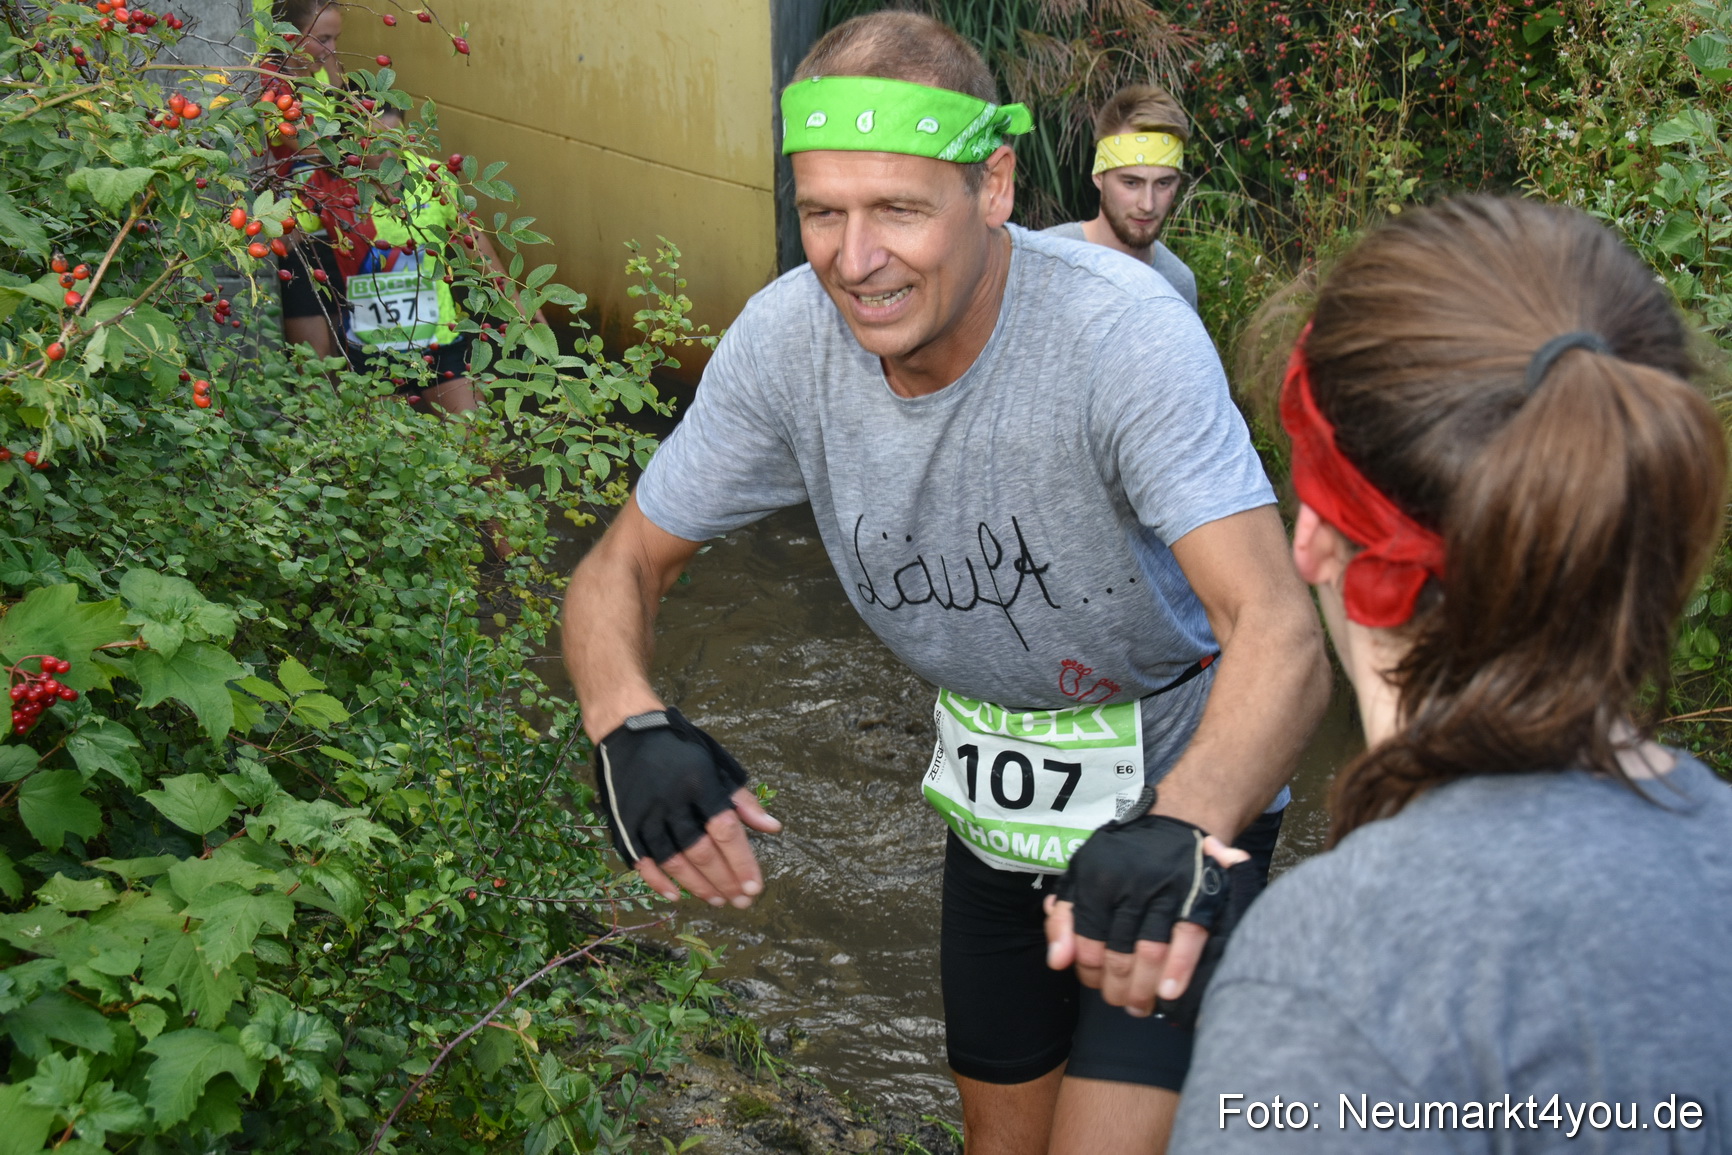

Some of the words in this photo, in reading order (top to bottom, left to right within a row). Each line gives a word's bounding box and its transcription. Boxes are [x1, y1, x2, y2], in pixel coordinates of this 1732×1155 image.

[368, 297, 417, 324] 157
[957, 743, 1082, 813] 107
[1116, 765, 1134, 775] E6
[950, 810, 1086, 864] THOMAS
